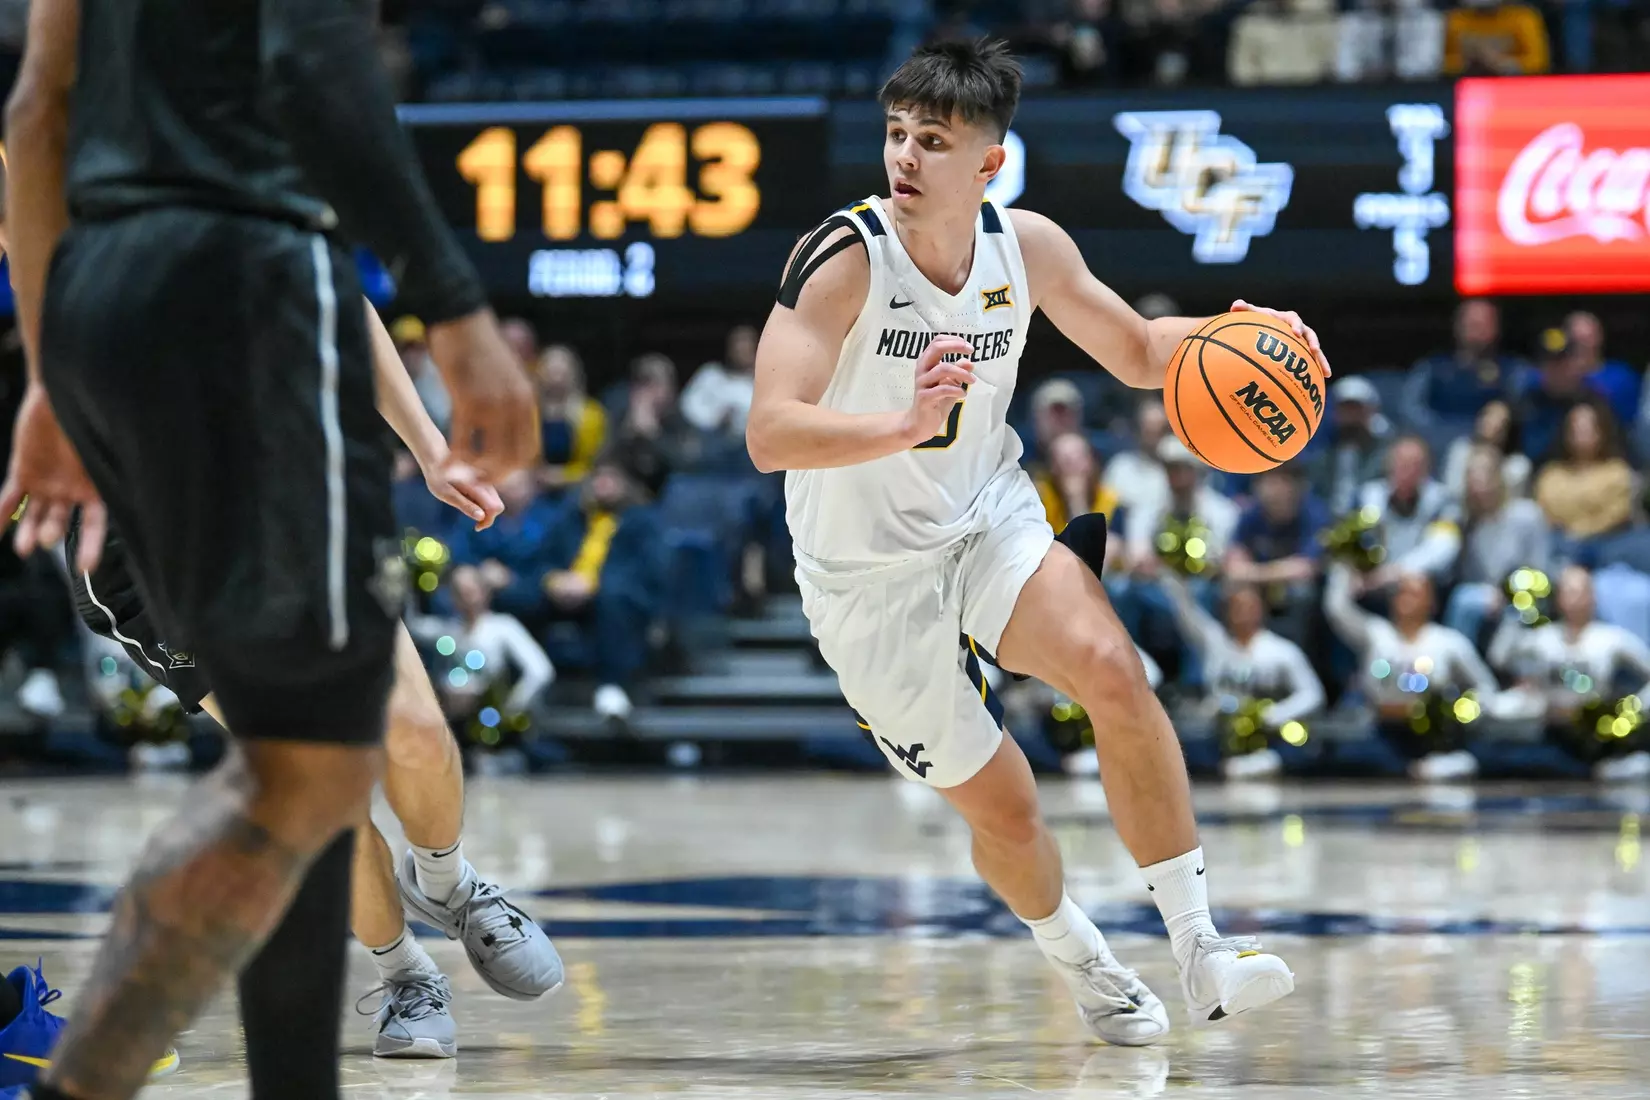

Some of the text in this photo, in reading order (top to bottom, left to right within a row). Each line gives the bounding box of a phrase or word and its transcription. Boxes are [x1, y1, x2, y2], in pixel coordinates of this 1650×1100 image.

[456, 122, 761, 242] 11:43
[1120, 113, 1288, 260] UCF
[982, 286, 1013, 311] XII
[876, 328, 1013, 363] MOUNNEERS
[1256, 331, 1323, 417] Wilson
[1229, 394, 1253, 421] OFFICIAL
[1235, 381, 1296, 445] NCAA
